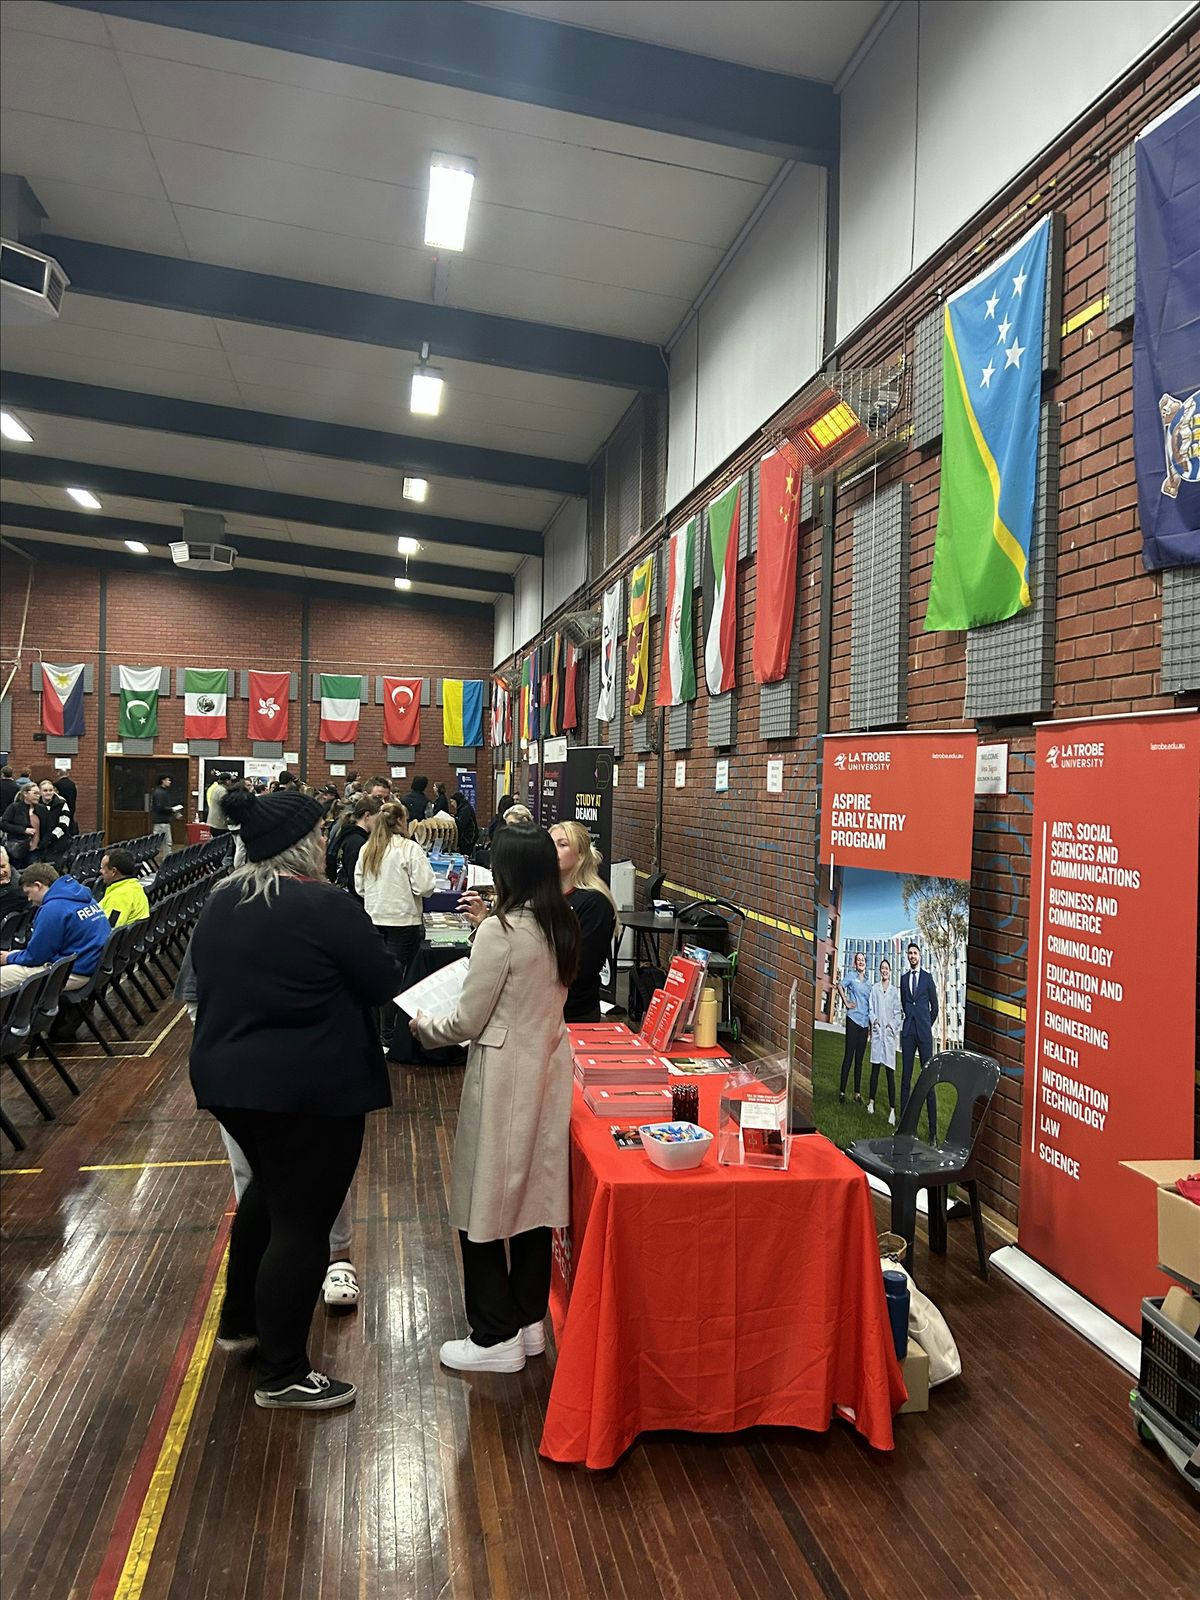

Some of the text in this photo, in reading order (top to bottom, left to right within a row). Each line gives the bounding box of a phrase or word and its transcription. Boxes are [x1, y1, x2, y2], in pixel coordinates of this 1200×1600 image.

[848, 752, 891, 763] LA TROBE
[1061, 758, 1104, 768] UNIVERSITY
[1062, 743, 1105, 757] LA TROBE
[848, 763, 890, 771] UNIVERSITY
[575, 793, 602, 807] STUDY AT
[832, 793, 872, 810] ASPIRE
[575, 807, 598, 821] DEAKIN
[831, 811, 906, 831] EARLY ENTRY
[831, 830, 886, 850] PROGRAM
[1051, 821, 1113, 843] ARTS, SOCIAL
[1051, 841, 1119, 865] SCIENCES AND
[1050, 860, 1140, 889] COMMUNICATIONS
[1049, 887, 1118, 917] BUSINESS AND
[1048, 906, 1102, 935] COMMERCE
[1047, 934, 1113, 968] CRIMINOLOGY
[1046, 963, 1123, 1002] EDUCATION AND
[1046, 982, 1092, 1014] TEACHING
[1044, 1010, 1109, 1050] ENGINEERING
[1043, 1038, 1079, 1069] HEALTH
[1042, 1066, 1109, 1113] INFORMATION
[1041, 1085, 1106, 1132] TECHNOLOGY
[1040, 1113, 1061, 1139] LAW
[1039, 1142, 1080, 1180] SCIENCE
